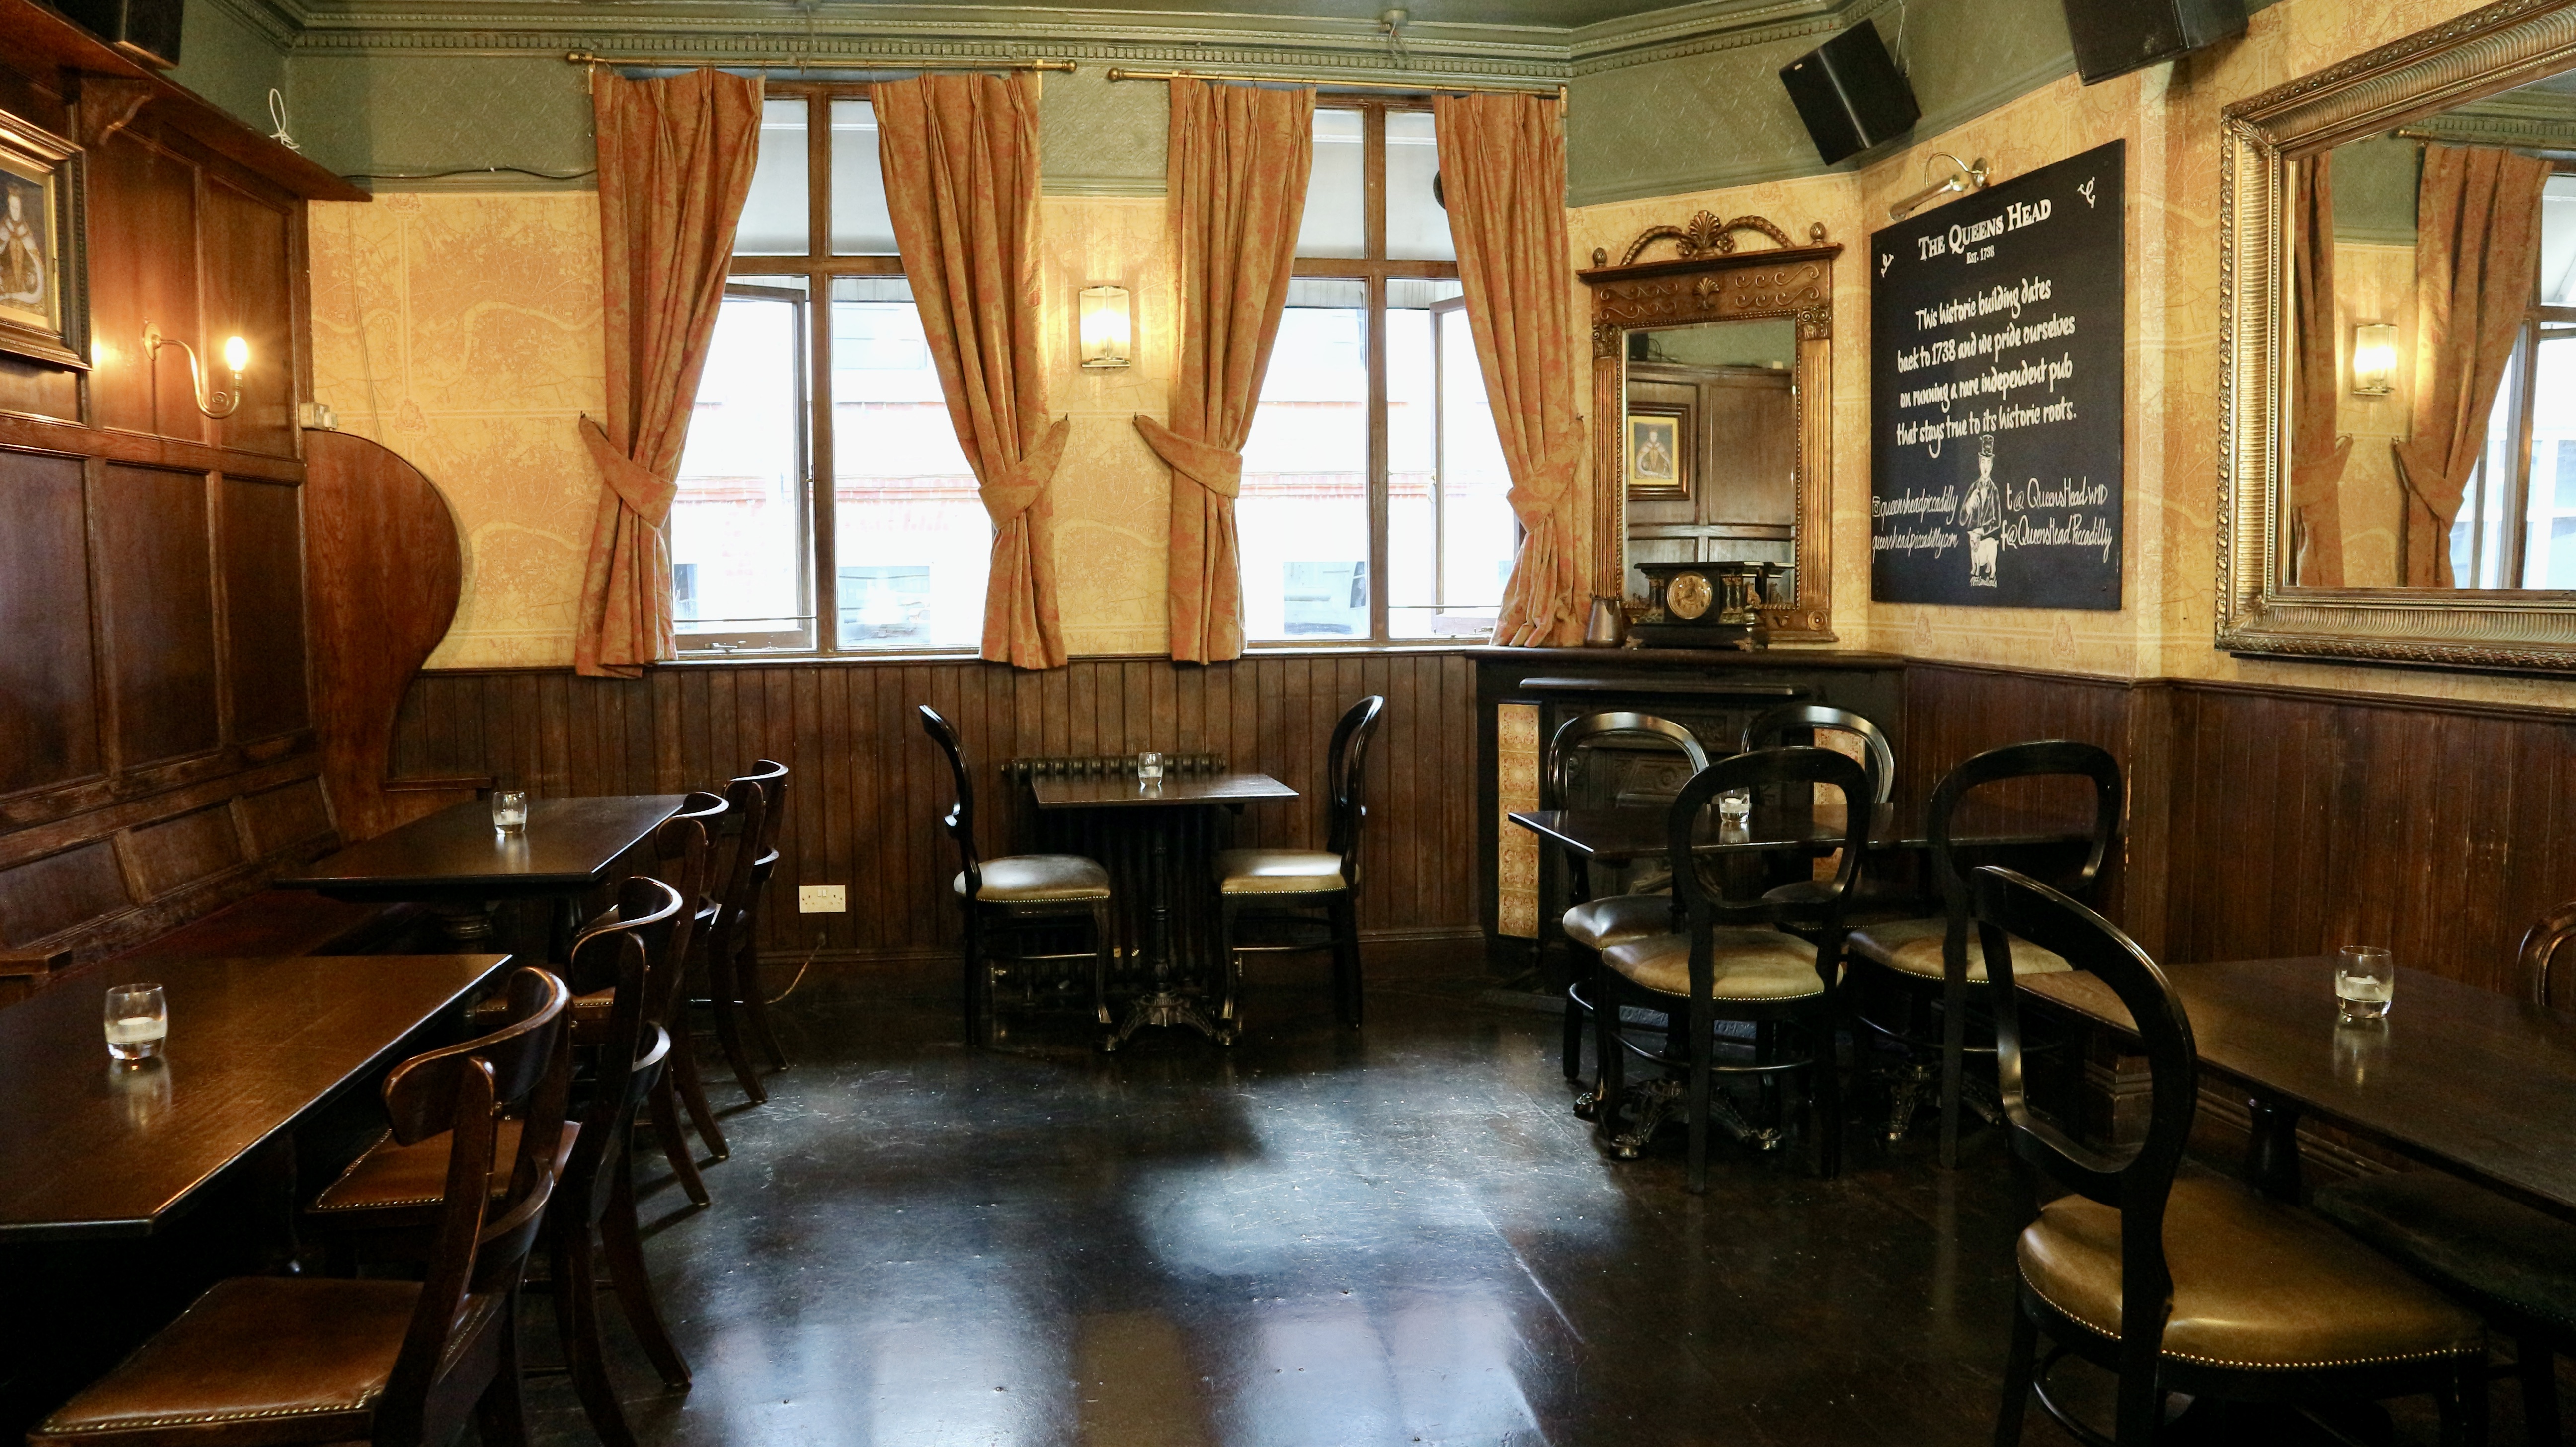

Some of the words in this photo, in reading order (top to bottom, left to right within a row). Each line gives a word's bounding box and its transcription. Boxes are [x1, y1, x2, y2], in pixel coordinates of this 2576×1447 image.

[1918, 235, 1945, 261] THE
[1949, 215, 2004, 254] QUEENS
[2006, 199, 2052, 231] HEAD
[1980, 245, 1995, 261] 1738
[1916, 307, 1937, 331] This
[1939, 297, 1976, 325] historic
[1978, 285, 2021, 319] building
[2021, 276, 2051, 304] dates
[1898, 347, 1919, 373] back
[1919, 345, 1931, 366] to
[1932, 338, 1956, 366] 1738
[1958, 331, 1977, 359] and
[1978, 333, 1992, 354] we
[1994, 322, 2021, 362] pride
[2023, 313, 2076, 343] ourselves
[1900, 391, 1912, 408] on
[1913, 382, 1950, 413] running
[1951, 383, 1958, 400] a
[1959, 378, 1979, 397] rare
[1981, 357, 2048, 400] independent
[2049, 352, 2073, 392] pub
[1897, 421, 1918, 446] that
[1919, 419, 1945, 458] stays
[1946, 415, 1968, 439] true
[1969, 411, 1980, 434] to
[1983, 408, 1997, 432] its
[1999, 403, 2041, 429] historic
[2043, 396, 2077, 423] roots.
